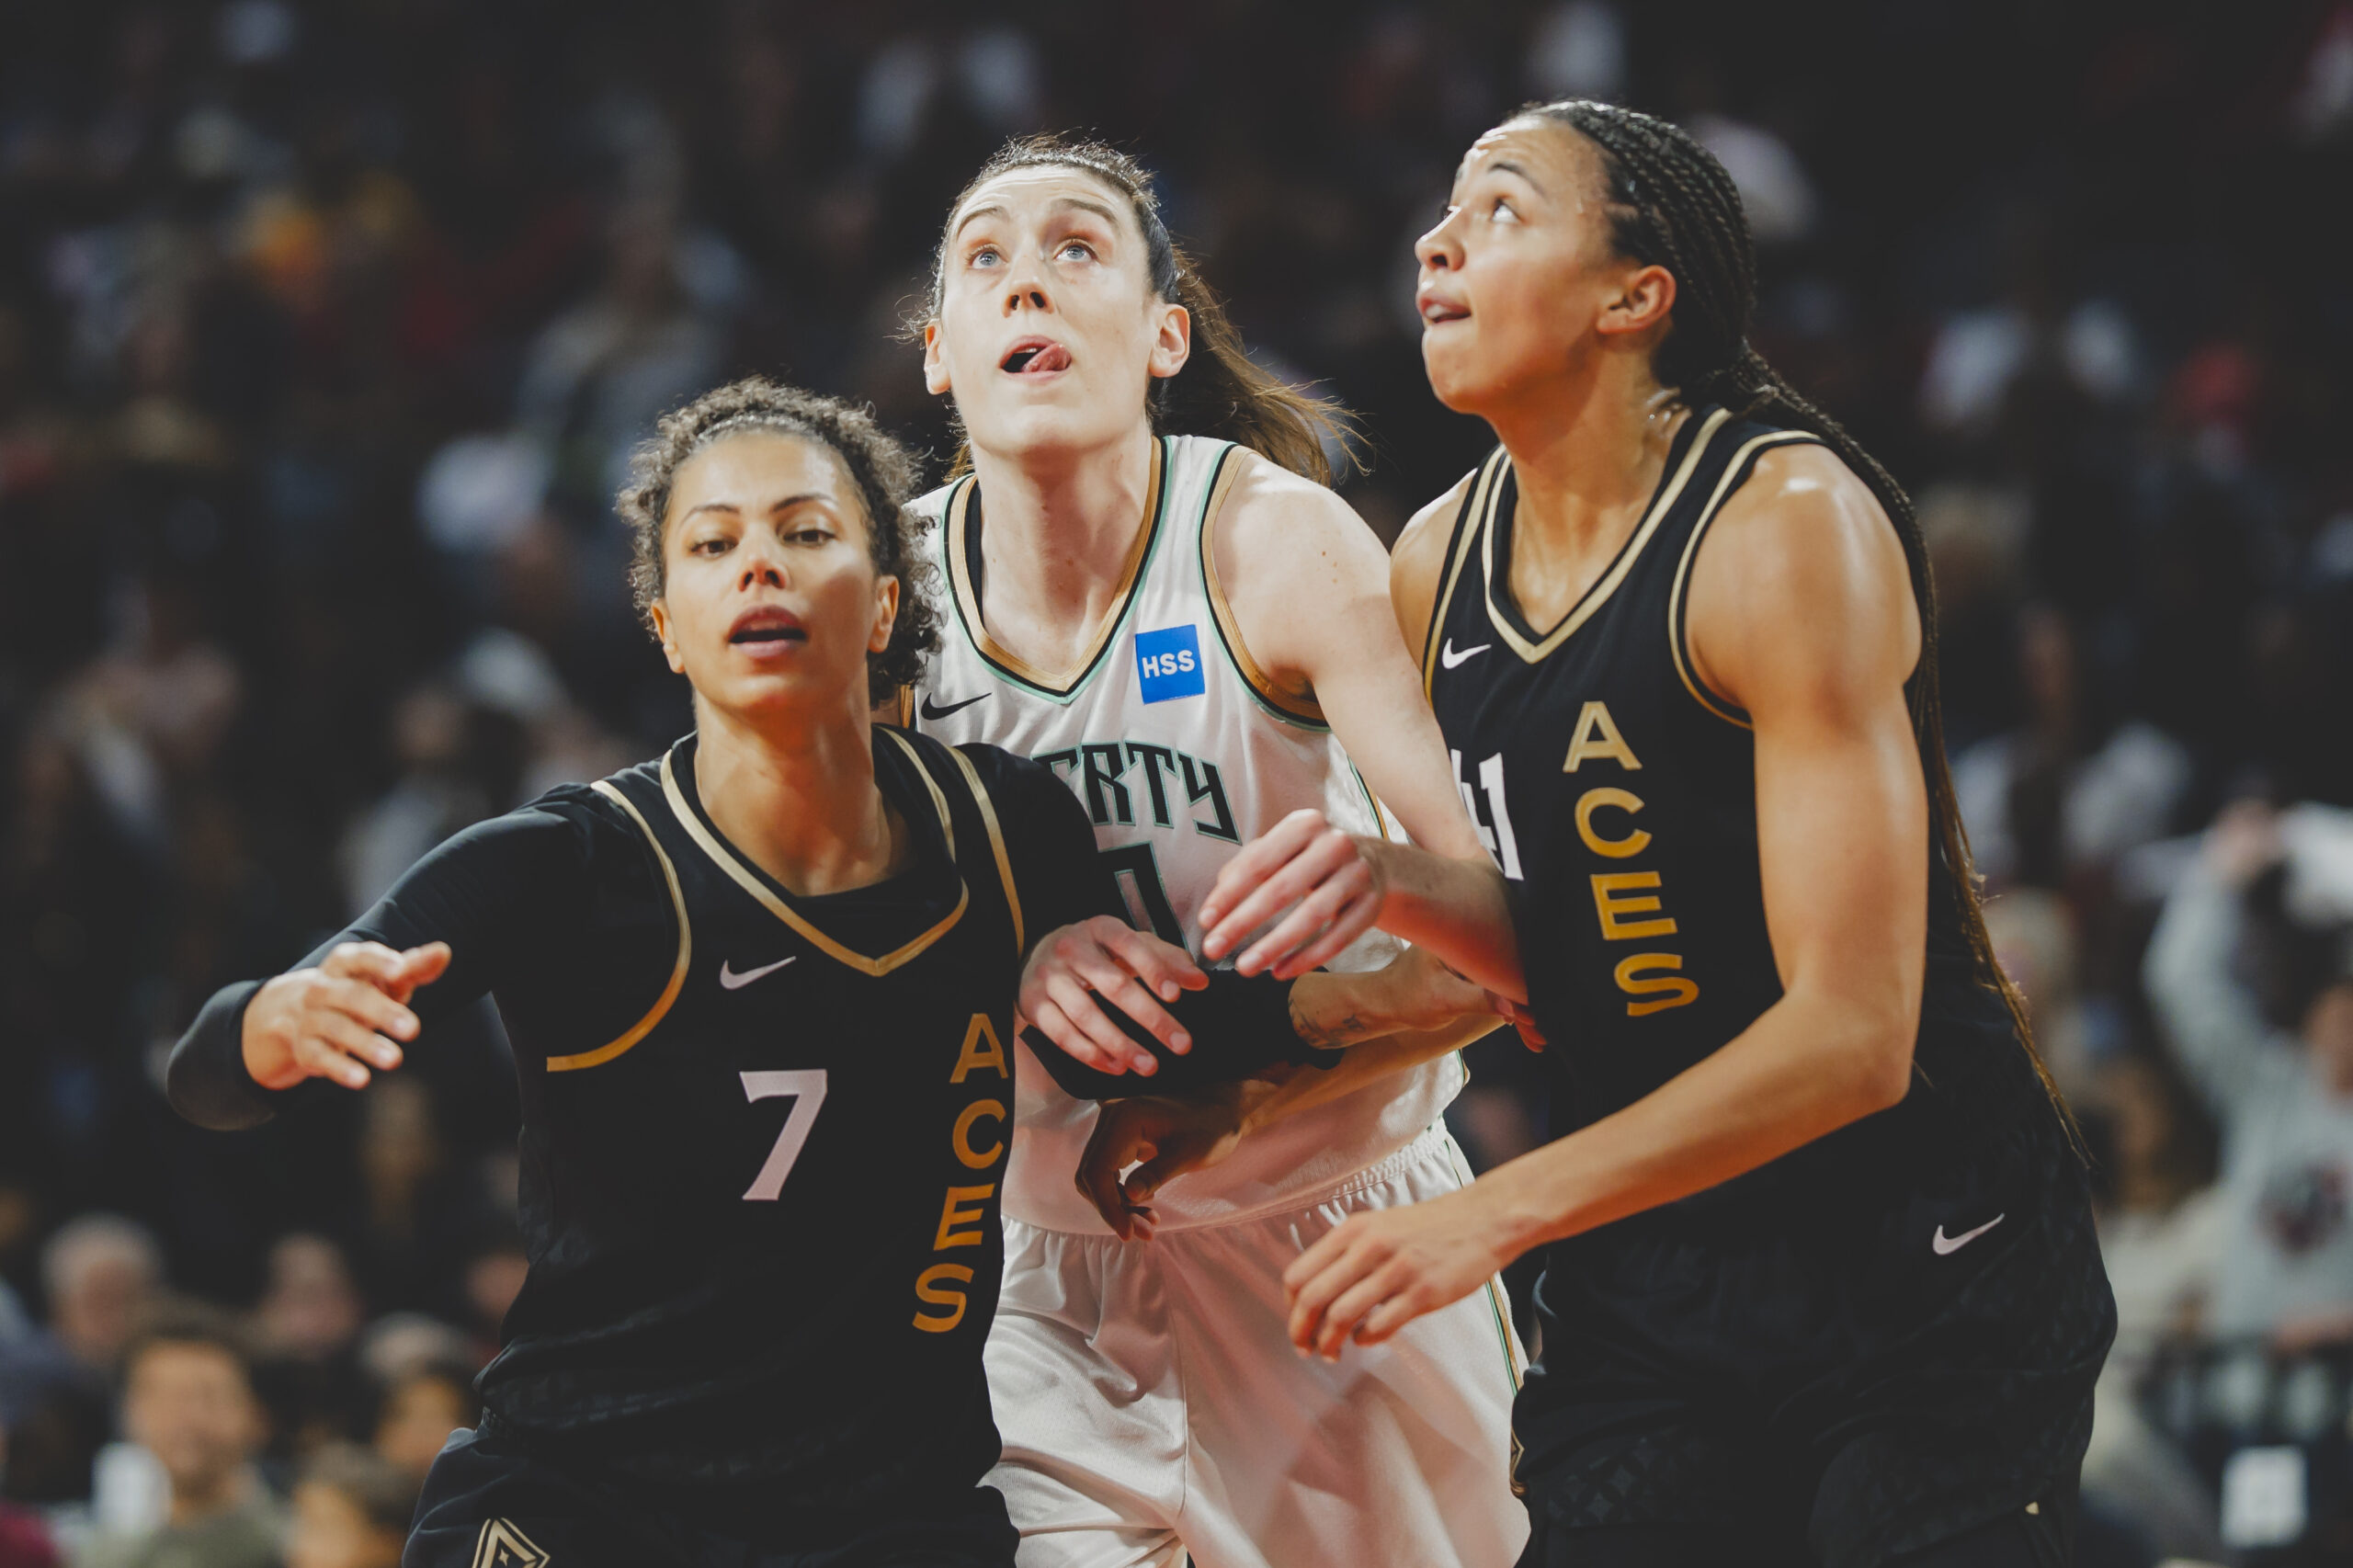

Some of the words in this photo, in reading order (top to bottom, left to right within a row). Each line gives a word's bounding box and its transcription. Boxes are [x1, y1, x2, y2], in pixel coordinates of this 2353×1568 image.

[1142, 649, 1196, 679] HSS
[1563, 700, 1699, 1017] ACES
[739, 1068, 827, 1200] 7
[912, 1013, 1009, 1333] ACES
